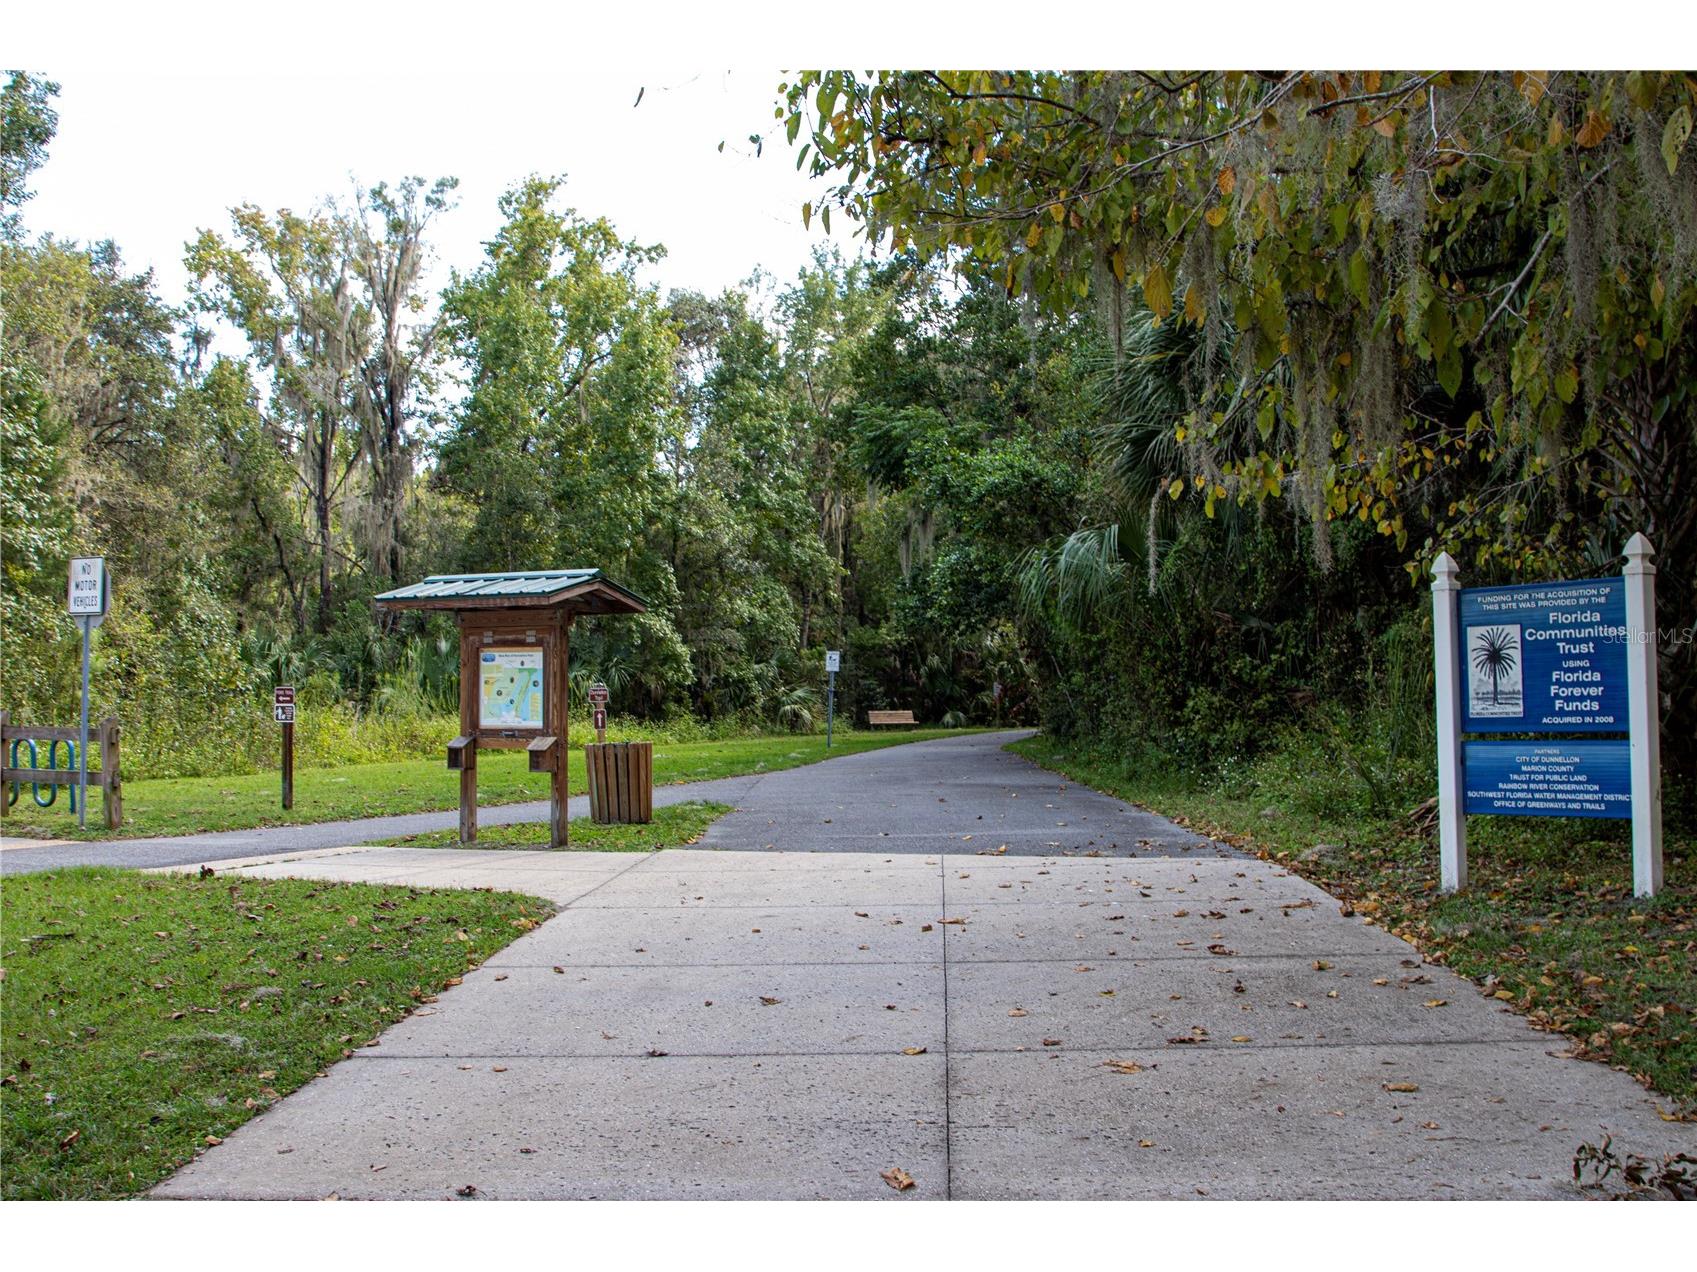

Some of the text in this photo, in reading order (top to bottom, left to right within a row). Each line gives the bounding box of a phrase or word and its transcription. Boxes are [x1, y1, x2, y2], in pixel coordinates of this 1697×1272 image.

[82, 563, 92, 575] NO
[75, 580, 97, 591] MOTOR
[73, 595, 98, 607] VEHICLES
[1477, 587, 1611, 603] FUNDING FOR THE ACQUISITION OF
[1482, 596, 1607, 611] THIS SITE WAS PROVIDED BY THE
[1549, 610, 1601, 624] Florida
[1525, 625, 1627, 641] Communities
[1556, 641, 1595, 654] Trust
[1562, 659, 1591, 668] USING
[1552, 670, 1602, 682] Florida
[1550, 685, 1605, 697] Forever
[1555, 699, 1600, 711] Funds
[1542, 716, 1583, 724] ACQUIRED
[1549, 783, 1600, 791] CONSERVATION
[1506, 791, 1533, 799] FLORIDA
[1556, 792, 1603, 800] MANAGEMENT
[1493, 800, 1516, 808] OFFICE
[1527, 801, 1567, 809] GREENWAYS
